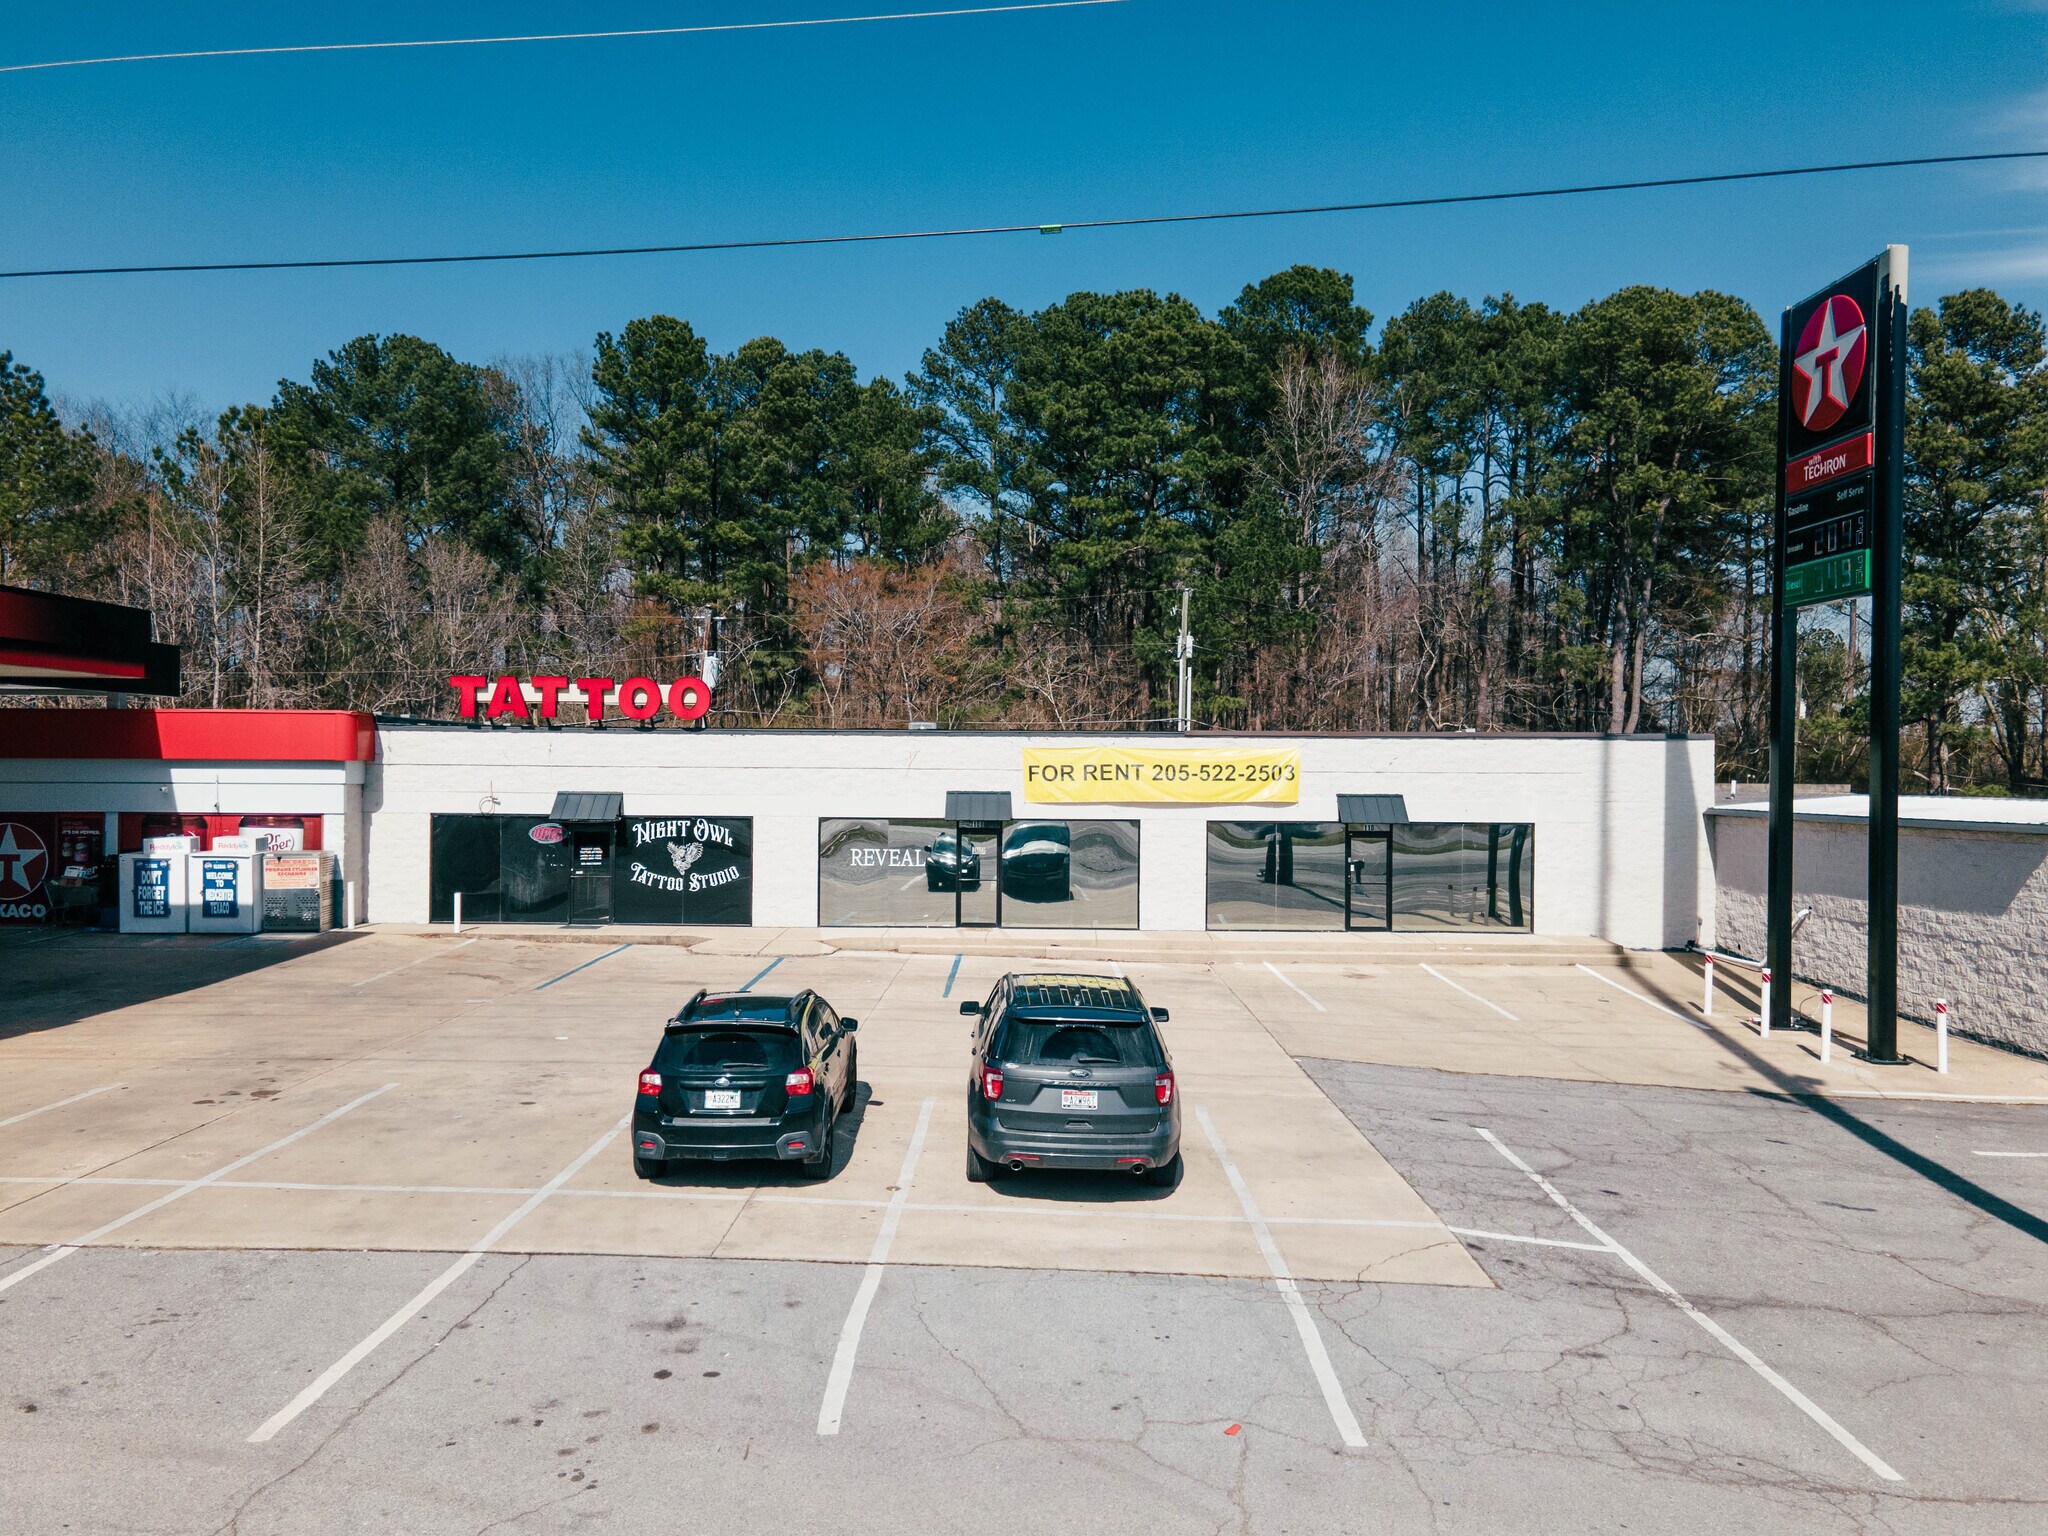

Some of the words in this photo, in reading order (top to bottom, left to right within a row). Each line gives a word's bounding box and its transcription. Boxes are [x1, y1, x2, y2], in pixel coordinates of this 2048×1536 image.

[1803, 454, 1847, 481] TECHRON
[1808, 454, 1822, 466] with
[1837, 488, 1849, 501] Self
[1848, 486, 1864, 498] Serve
[450, 676, 711, 721] TATTOO
[1028, 764, 1076, 782] FOR
[1083, 763, 1145, 781] RENT
[1151, 763, 1296, 782] 205-522-2503
[632, 820, 691, 848] NIGHT
[850, 848, 926, 867] REVEAL
[205, 871, 234, 880] WELCOME
[215, 879, 225, 887] TO
[630, 862, 684, 892] TATTOO
[688, 865, 740, 892] STUDIO
[137, 885, 166, 900] FORGET
[138, 901, 153, 915] THE
[153, 901, 165, 915] ICE
[210, 902, 230, 915] TEXACO
